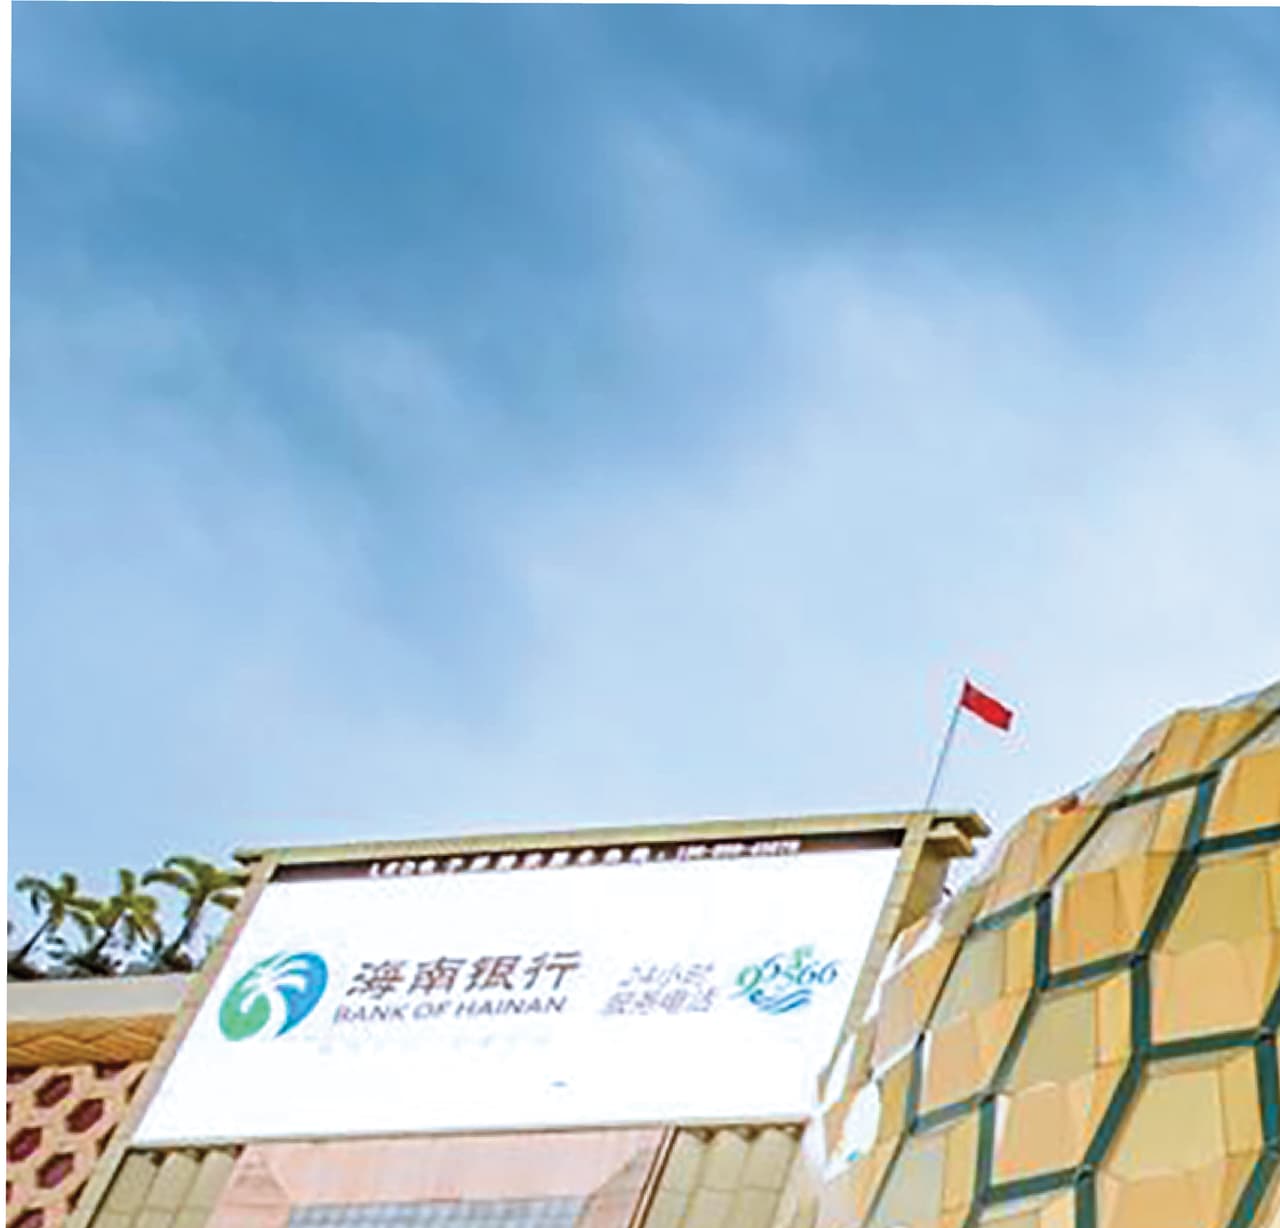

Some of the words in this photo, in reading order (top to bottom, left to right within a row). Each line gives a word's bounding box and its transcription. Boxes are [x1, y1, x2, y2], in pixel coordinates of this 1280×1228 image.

[346, 950, 582, 999] 海南银行
[333, 1003, 410, 1025] BANK
[412, 999, 453, 1021] OF
[455, 995, 569, 1018] HAINAN
